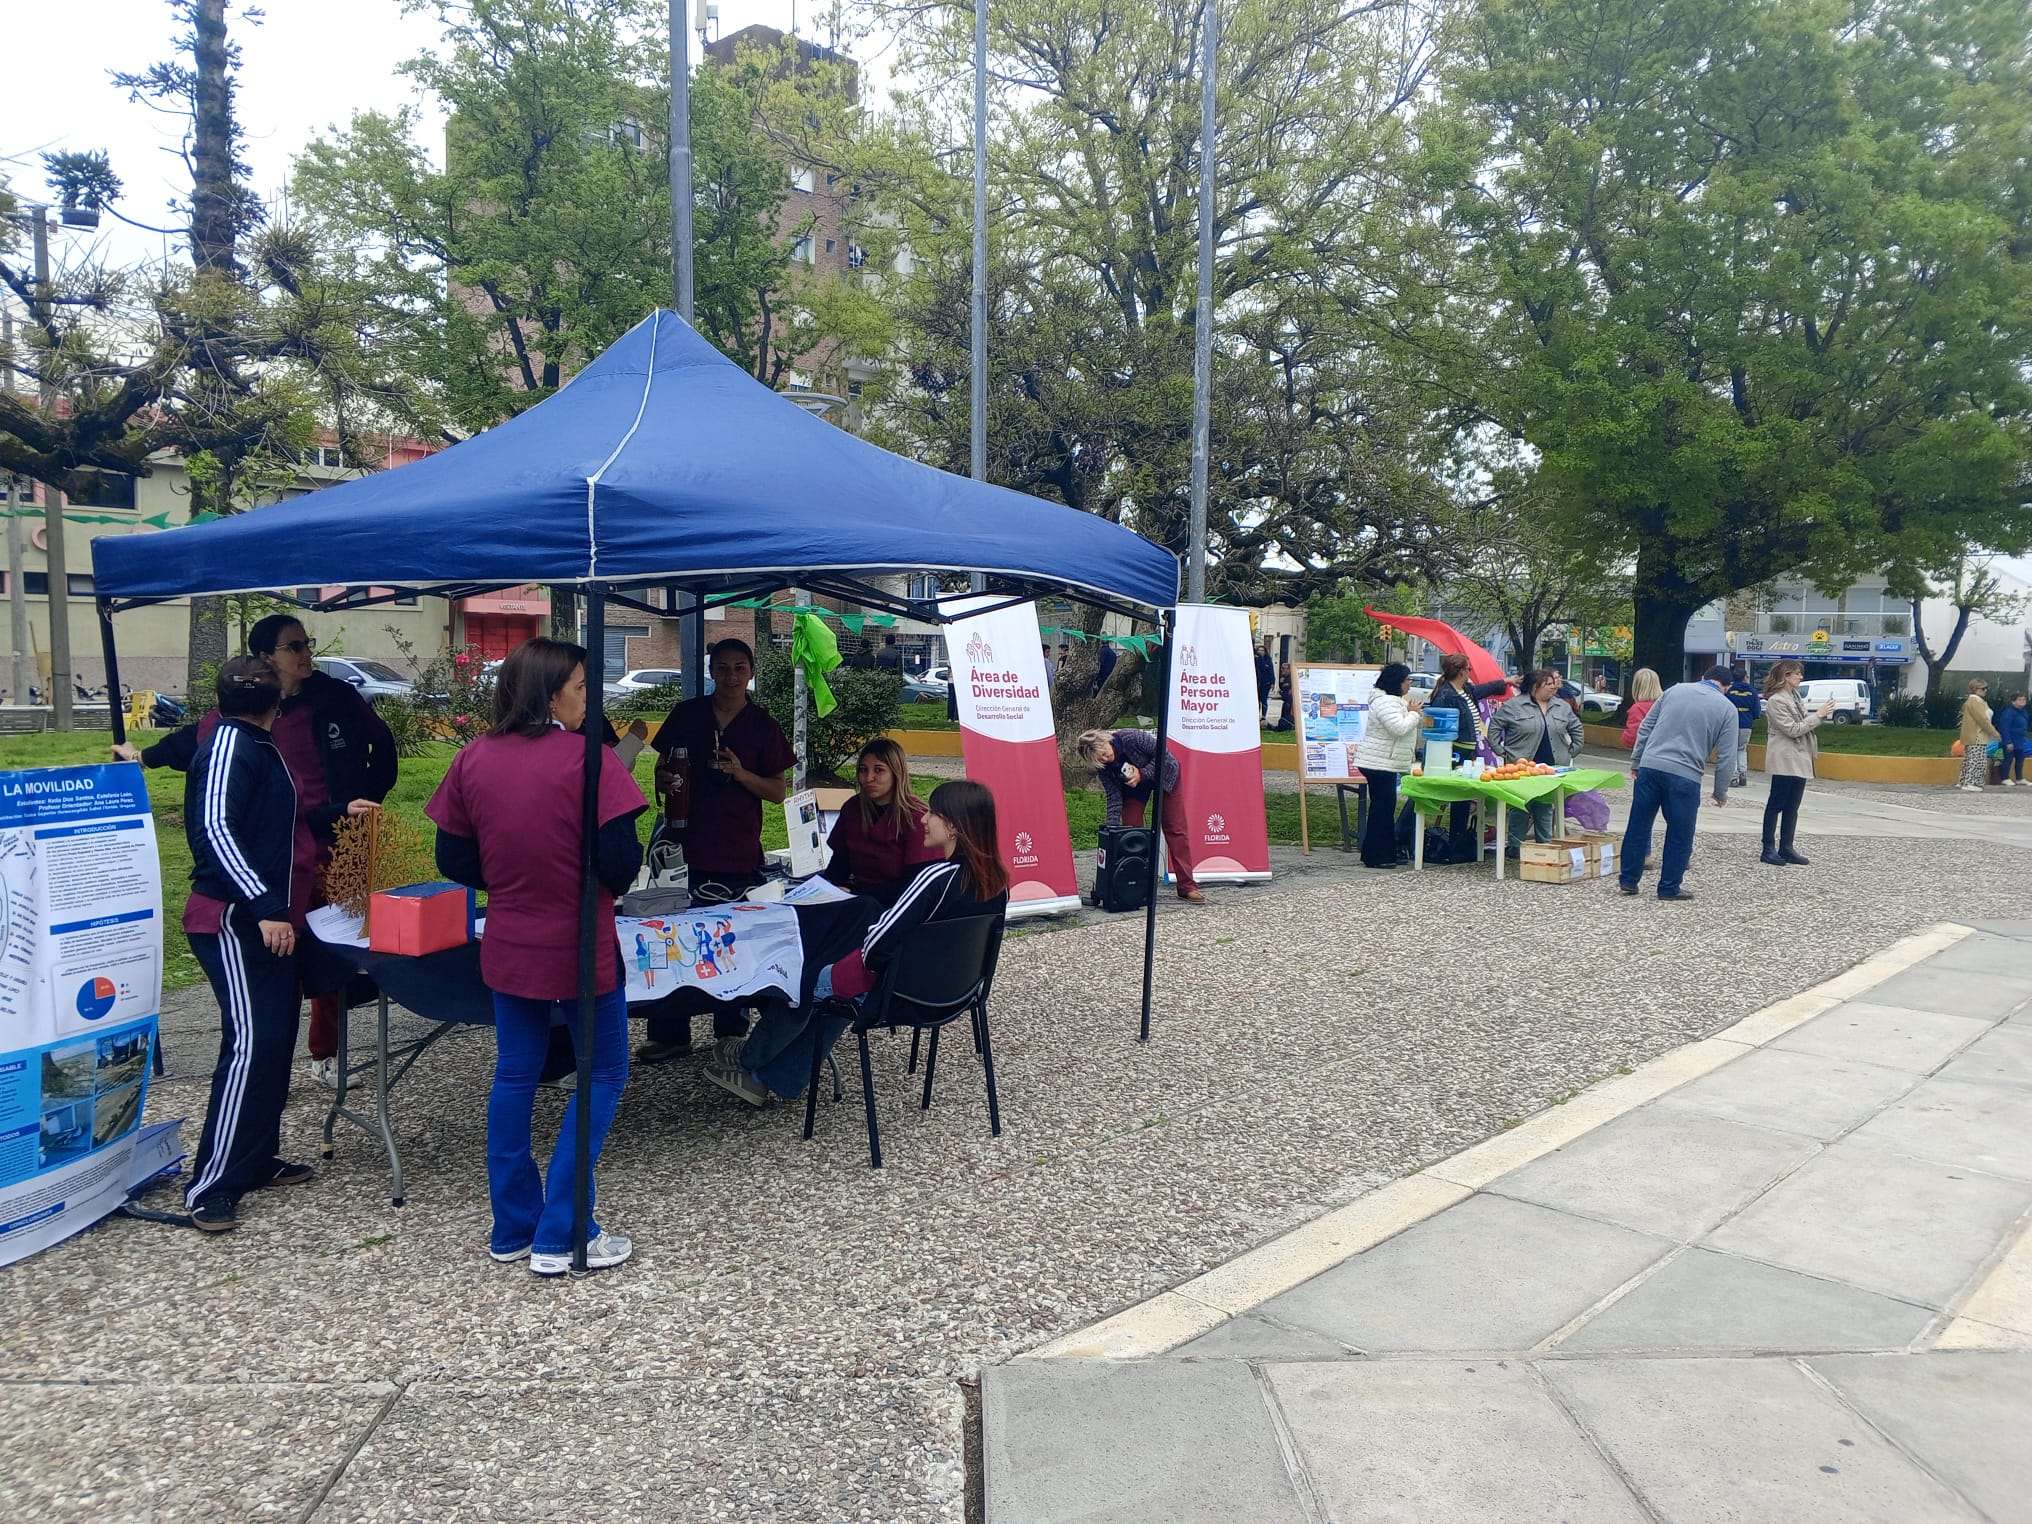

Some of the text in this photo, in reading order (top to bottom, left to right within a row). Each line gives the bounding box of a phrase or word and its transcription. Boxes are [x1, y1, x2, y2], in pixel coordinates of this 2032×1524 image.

[1769, 641, 1799, 651] Astro
[971, 665, 1018, 683] Área de
[1180, 668, 1226, 684] Área de
[972, 684, 1040, 698] Diversidad
[1180, 685, 1230, 698] Persona
[1181, 699, 1219, 714] Mayor
[3, 779, 94, 796] LA MOVILIDAD
[1204, 834, 1230, 842] FLORIDA
[1013, 855, 1039, 865] FLORIDA
